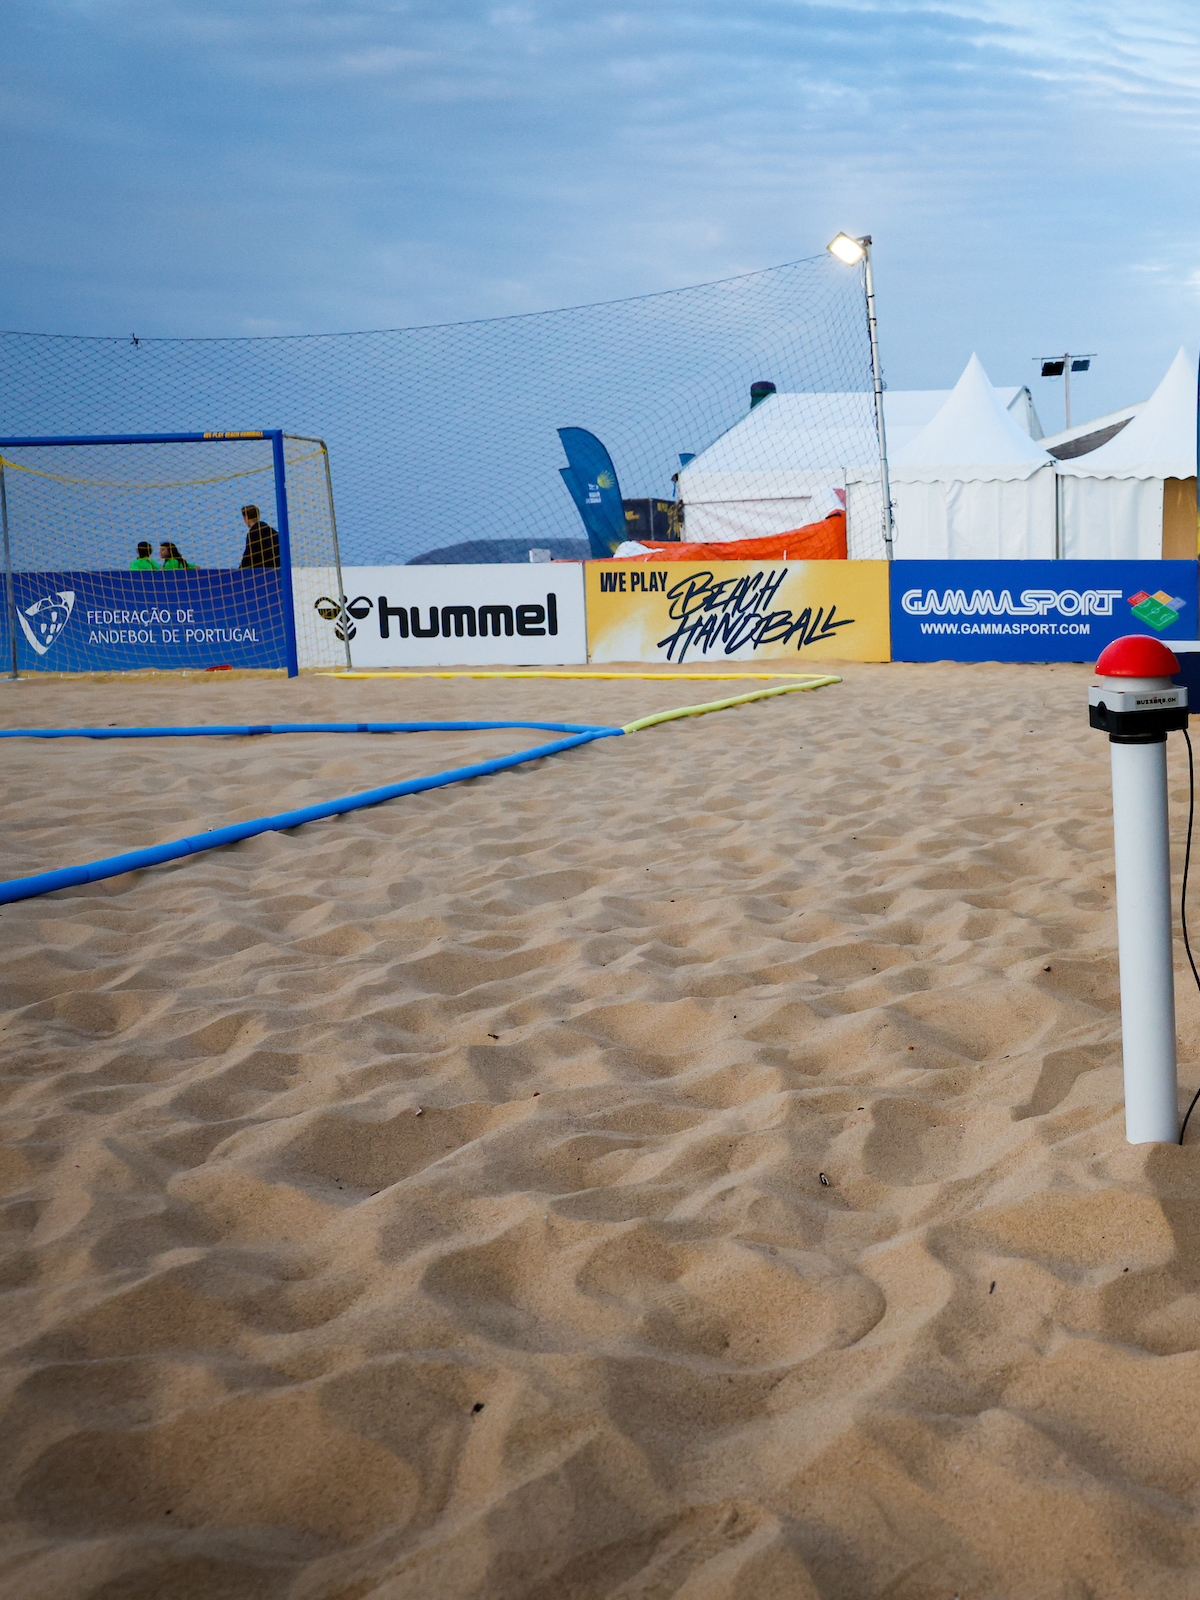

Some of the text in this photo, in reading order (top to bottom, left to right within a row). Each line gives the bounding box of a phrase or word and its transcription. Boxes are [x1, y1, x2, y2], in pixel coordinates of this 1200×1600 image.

[600, 568, 789, 619] WE PLAY BEACH
[87, 607, 195, 627] FEDERAÇÃO DE
[378, 593, 558, 638] hummel
[920, 623, 1090, 635] WWW.GAMMASPORT.COM
[88, 628, 259, 644] ANDEBOL DE PORTUGAL
[656, 605, 855, 664] HANDBALL
